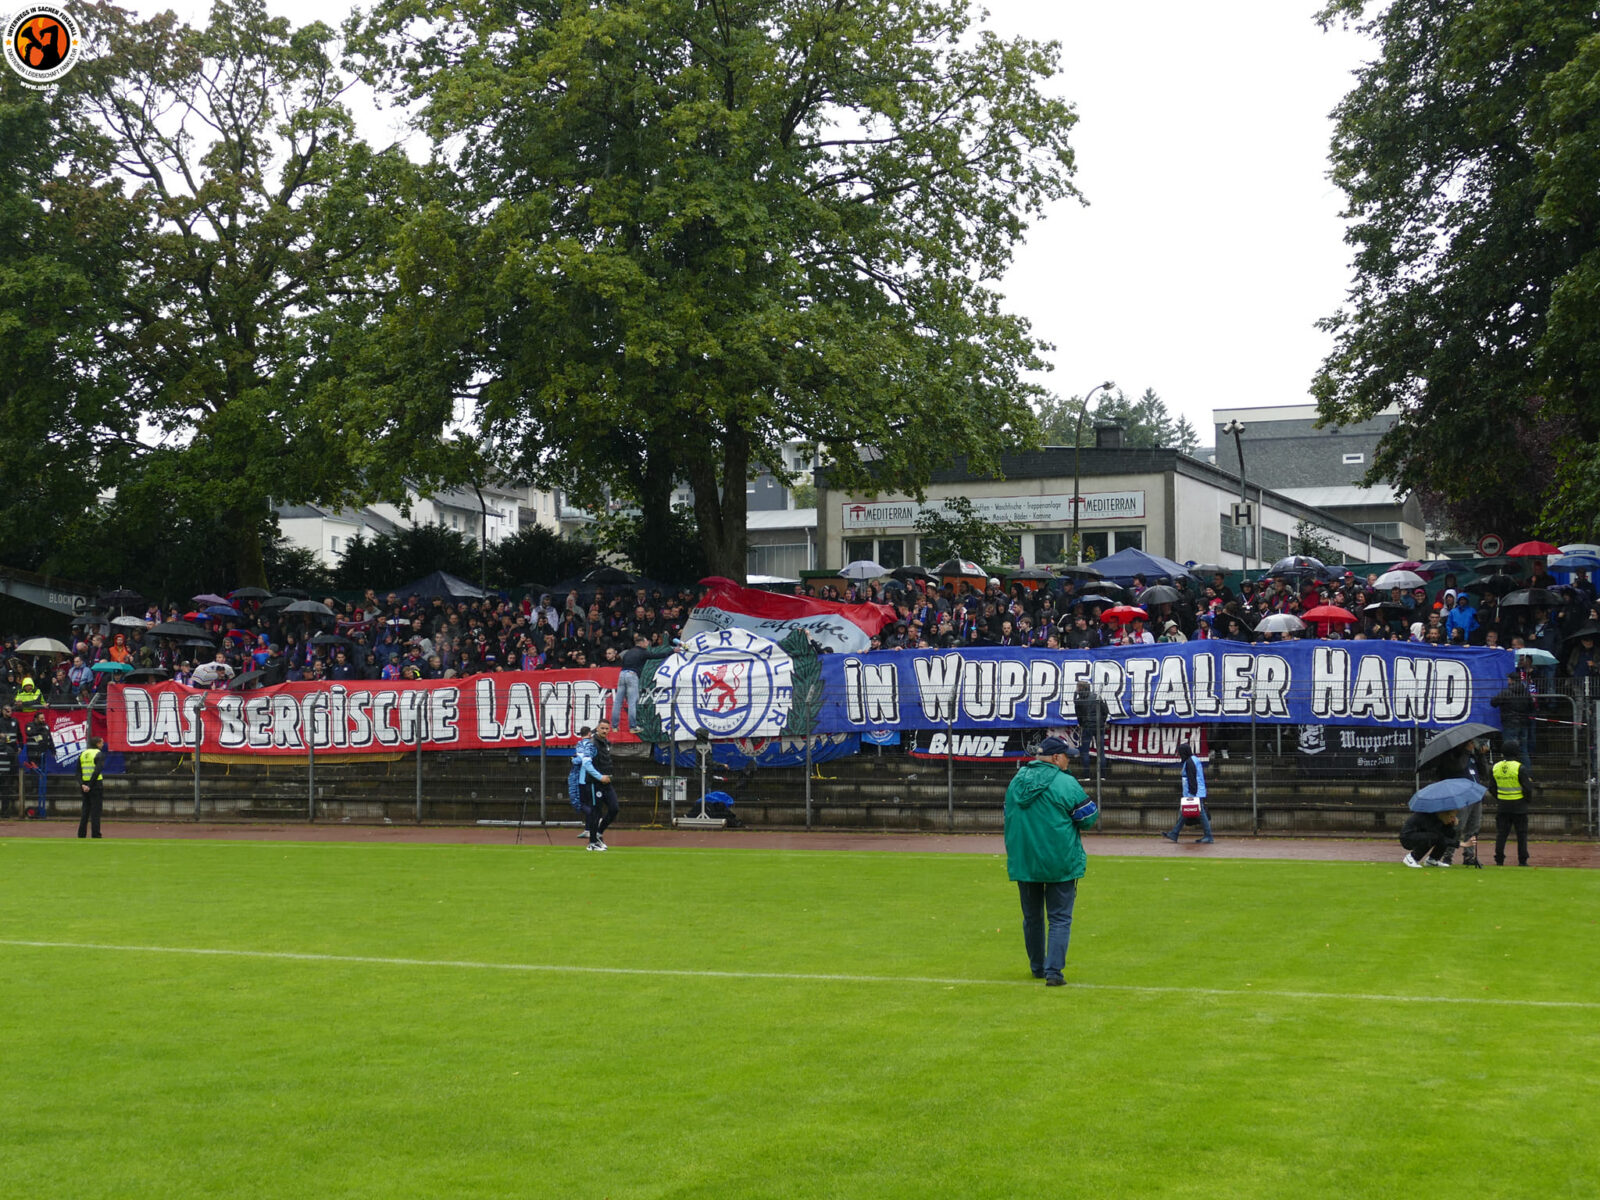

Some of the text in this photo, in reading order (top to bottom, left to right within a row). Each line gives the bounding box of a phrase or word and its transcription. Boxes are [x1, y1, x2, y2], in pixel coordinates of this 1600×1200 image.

[865, 507, 913, 520] MEDITERRAN
[1086, 497, 1136, 512] MEDITERRAN
[1235, 505, 1251, 525] H
[48, 592, 73, 606] BLOCK
[913, 652, 1292, 724] WUPPERTALER
[1310, 646, 1472, 724] HAND
[123, 686, 205, 748] DAS
[476, 678, 606, 744] LAND
[928, 733, 1010, 757] BANDE
[1339, 728, 1413, 752] Wuppertal
[1357, 757, 1377, 767] Since
